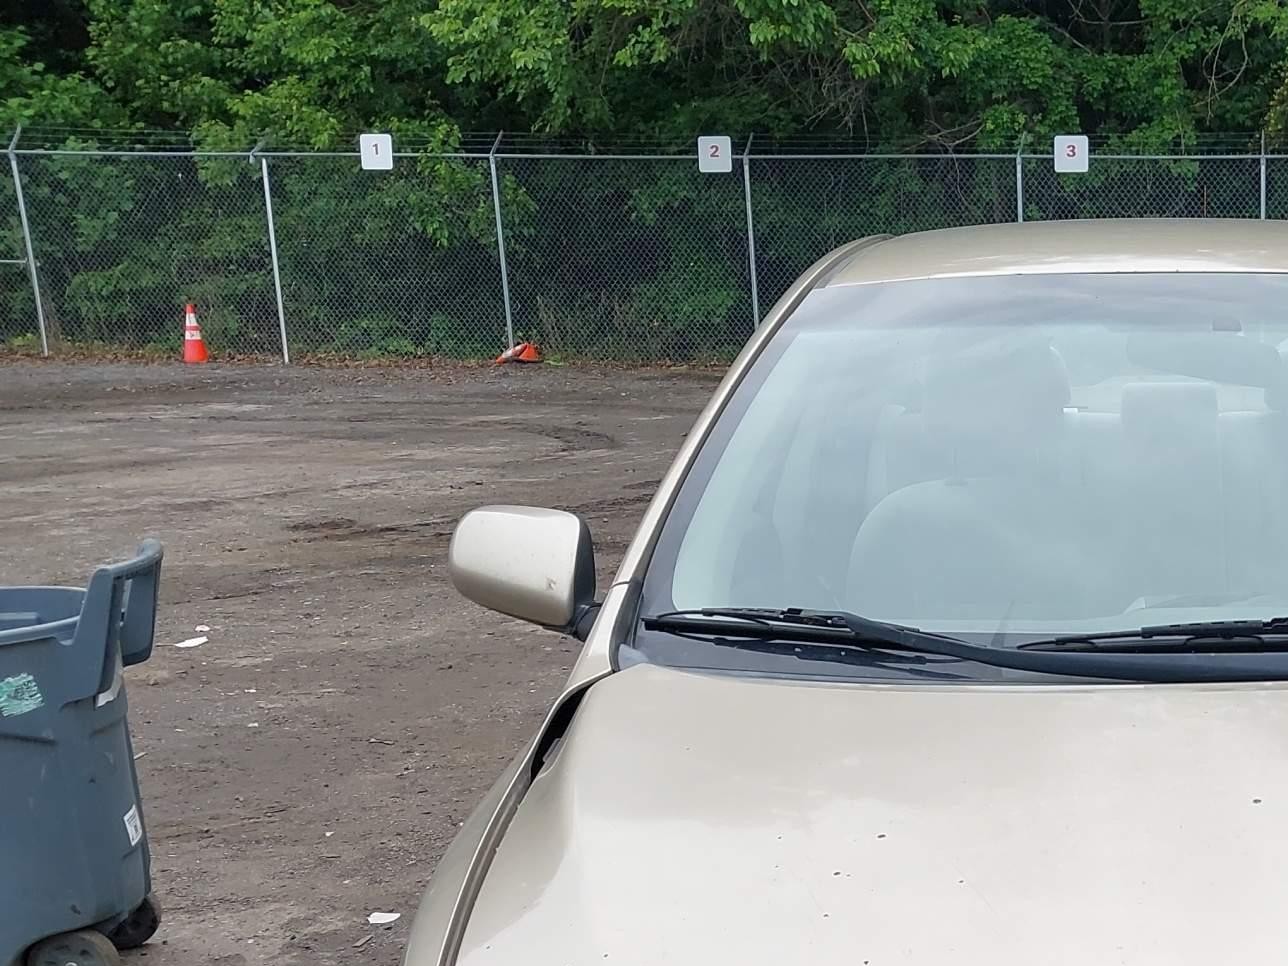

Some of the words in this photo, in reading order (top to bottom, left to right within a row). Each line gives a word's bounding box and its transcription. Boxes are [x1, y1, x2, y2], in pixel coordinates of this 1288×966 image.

[372, 143, 379, 156] 1
[709, 144, 720, 158] 2
[1066, 144, 1077, 158] 3
